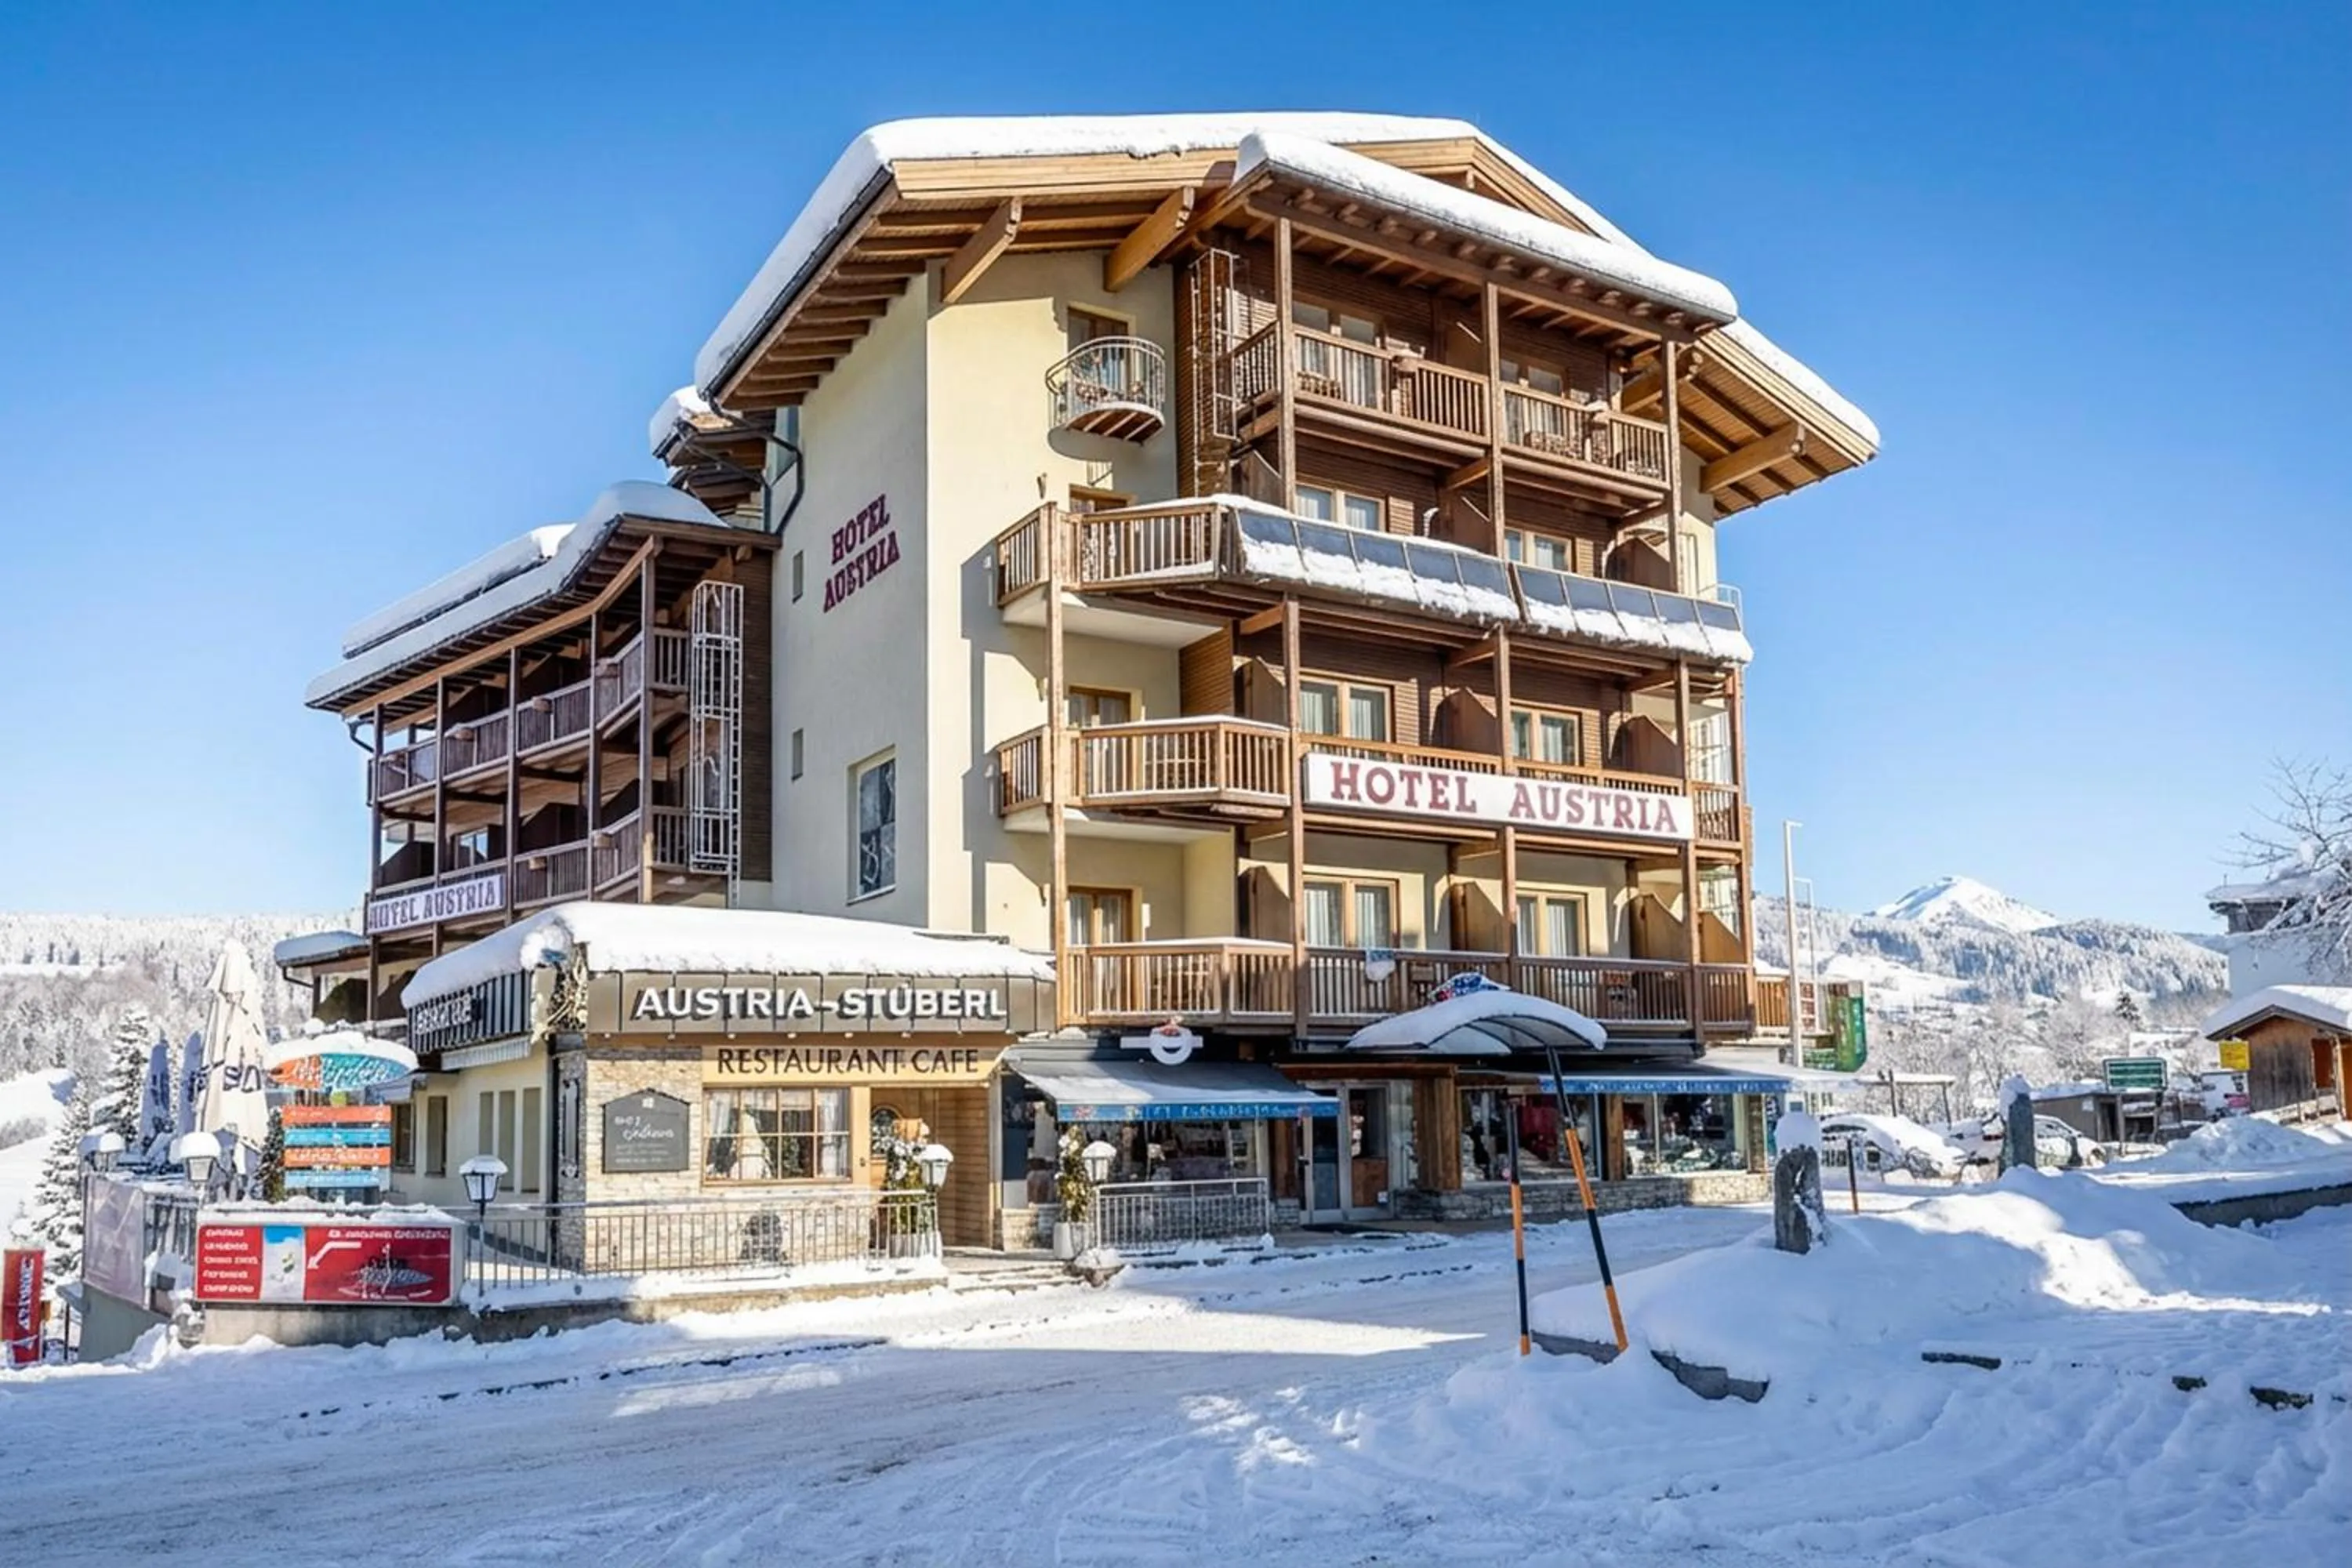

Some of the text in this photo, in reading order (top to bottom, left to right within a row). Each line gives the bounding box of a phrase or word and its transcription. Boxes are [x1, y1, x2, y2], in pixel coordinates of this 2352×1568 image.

[1330, 761, 1679, 833] HOTEL AUSTRIA
[369, 880, 495, 929] HOTEL AUSTRIA
[717, 1048, 979, 1074] RESTAURANT CAFE
